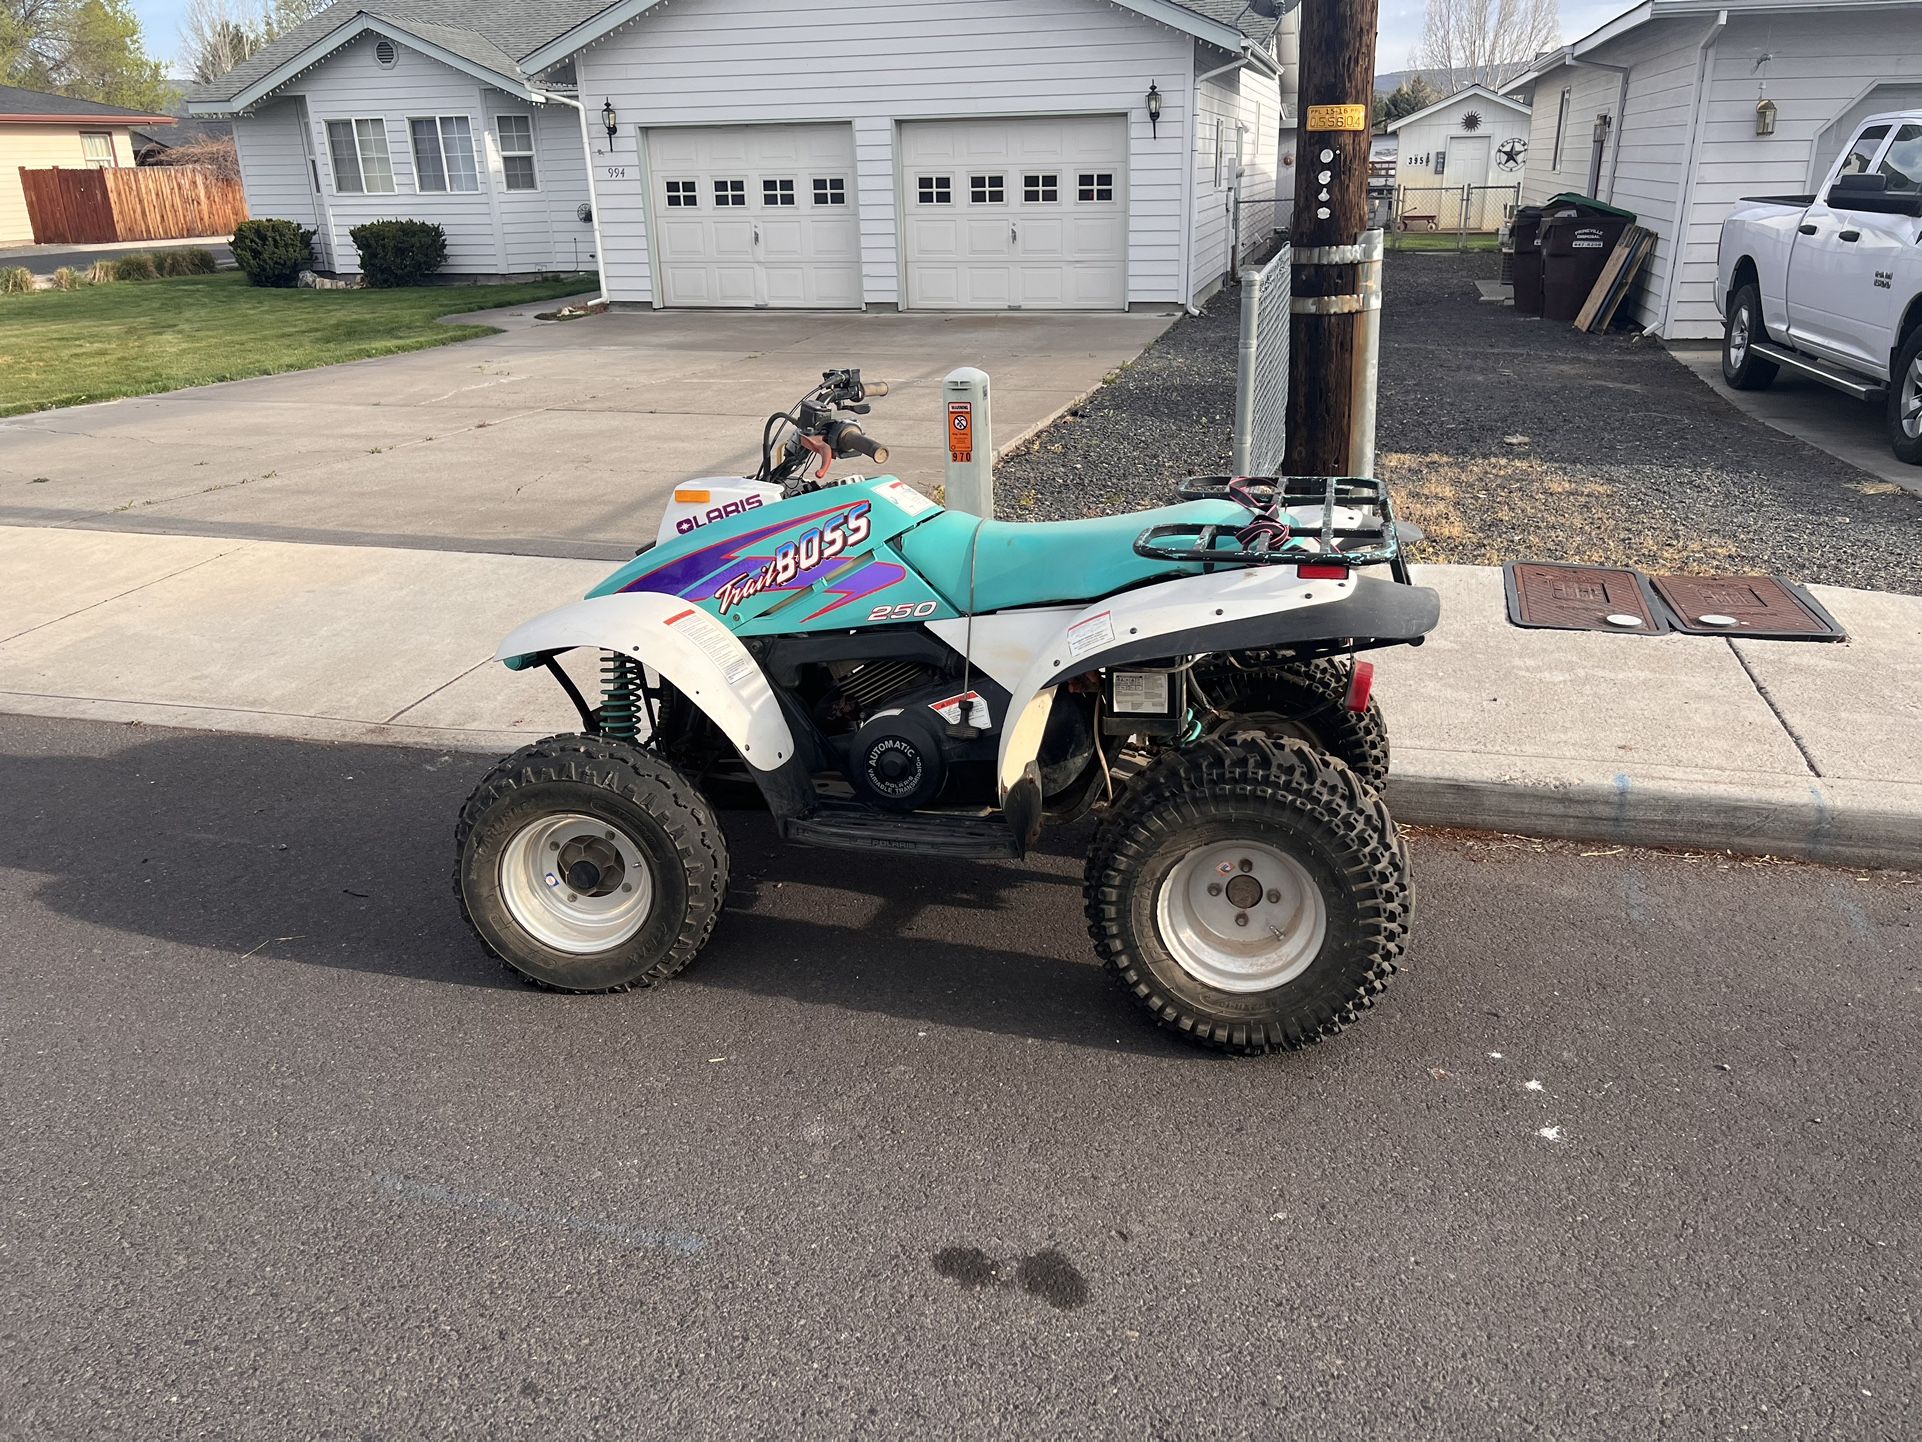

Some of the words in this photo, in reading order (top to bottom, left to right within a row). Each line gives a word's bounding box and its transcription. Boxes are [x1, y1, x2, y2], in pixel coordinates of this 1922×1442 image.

[1408, 156, 1424, 165] 395
[608, 168, 625, 178] 994
[952, 452, 971, 462] 970
[714, 558, 779, 616] Trail
[774, 501, 870, 585] BOSS
[867, 601, 938, 622] 250
[868, 739, 915, 767] AUTOMATIC
[872, 840, 916, 849] POLARIS
